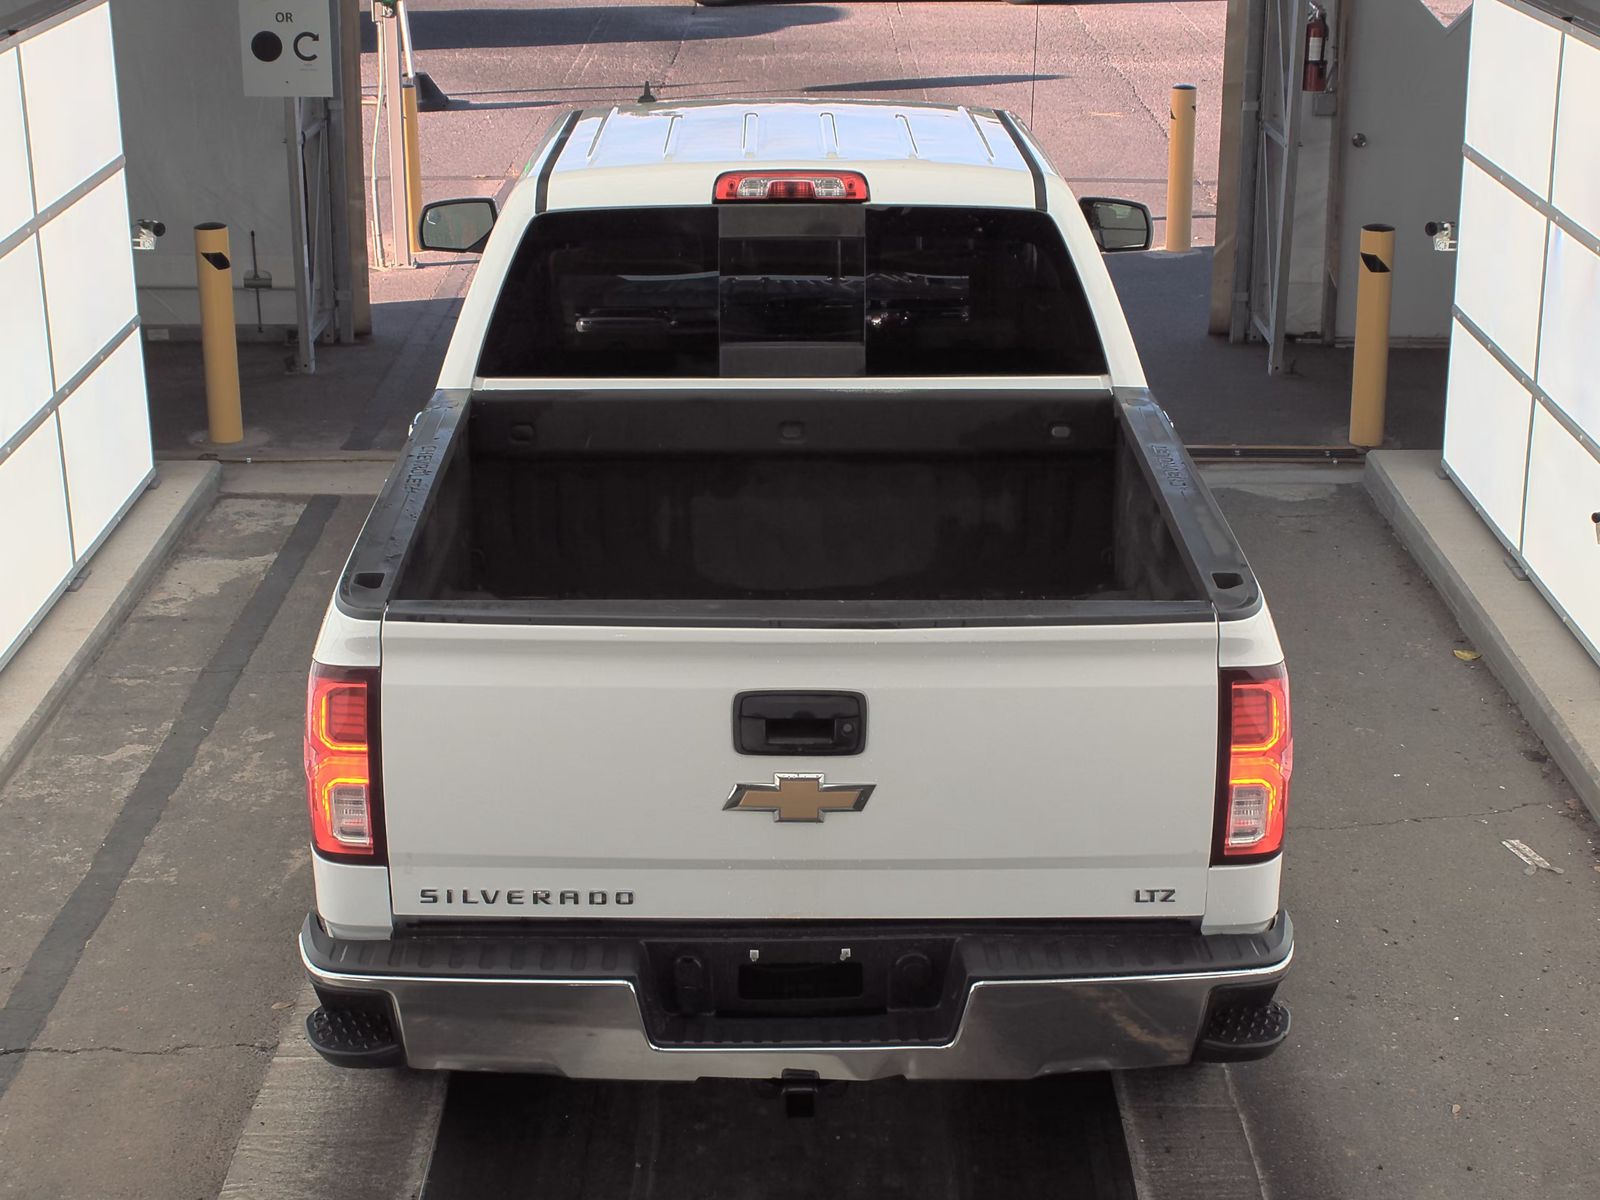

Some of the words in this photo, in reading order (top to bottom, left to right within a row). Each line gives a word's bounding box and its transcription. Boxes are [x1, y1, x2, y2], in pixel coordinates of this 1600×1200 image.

[275, 12, 293, 23] OR
[419, 888, 635, 906] SILVERADO
[1134, 888, 1176, 903] LTZ
